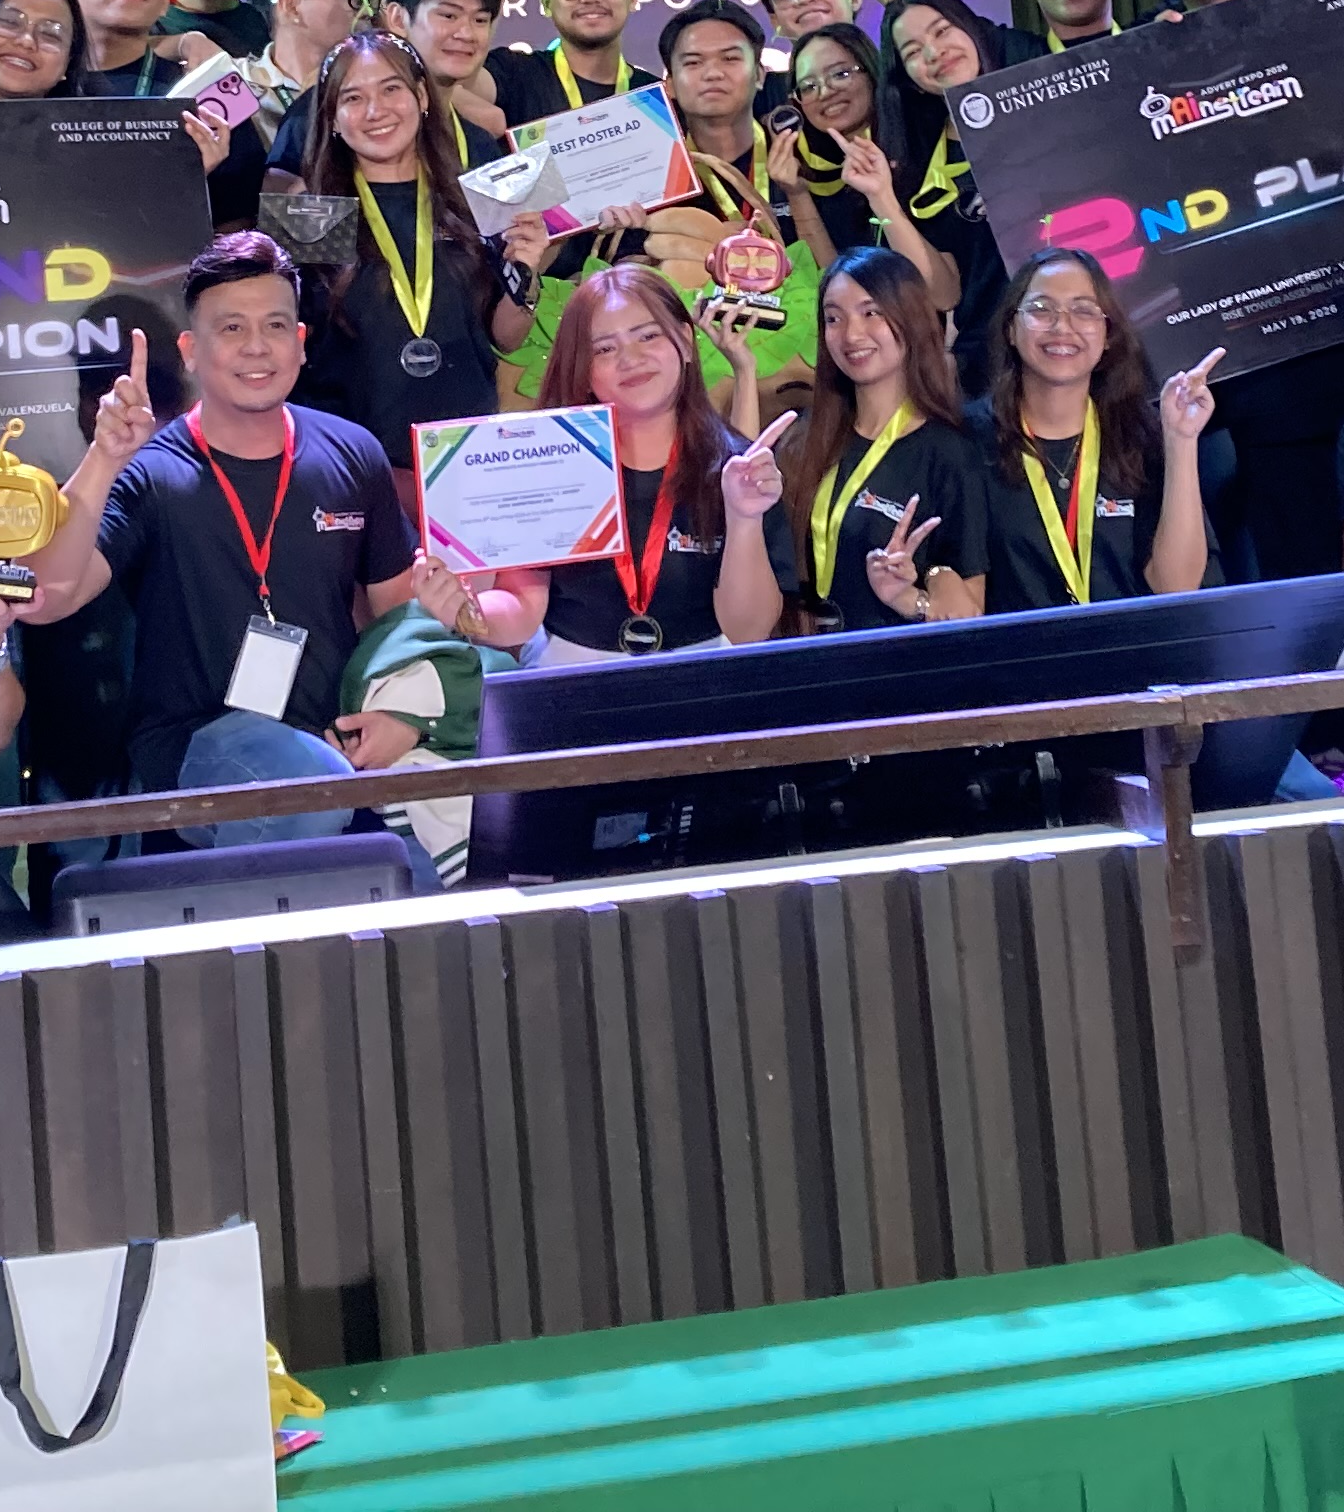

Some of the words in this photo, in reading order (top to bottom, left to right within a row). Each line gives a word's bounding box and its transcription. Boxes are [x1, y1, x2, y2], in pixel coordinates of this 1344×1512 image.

[996, 86, 1019, 100] OUR
[1020, 77, 1048, 92] LADY
[1052, 71, 1066, 82] OF
[1067, 59, 1109, 77] FATIMA
[999, 68, 1110, 113] UNIVERSITY
[1200, 79, 1237, 96] ADVERT
[1239, 71, 1264, 85] EXPO
[1266, 63, 1288, 76] 2026
[51, 122, 104, 131] COLLEGE
[107, 121, 121, 130] OF
[125, 120, 179, 130] BUSINESS
[58, 133, 83, 142] AND
[86, 131, 171, 142] ACCOUNTANCY
[550, 139, 577, 155] BEST
[578, 125, 622, 146] POSTER
[625, 119, 641, 132] AD
[1040, 189, 1229, 280] 2ND
[1166, 310, 1190, 325] OUR
[1190, 302, 1218, 318] LADY
[1219, 297, 1234, 309] OF
[1234, 285, 1274, 305] FATIMA
[1274, 266, 1331, 291] UNIVERSITY
[1220, 309, 1245, 322] RISE
[1245, 297, 1281, 314] TOWER
[1261, 321, 1287, 335] MAY
[1309, 304, 1338, 320] 2026
[464, 451, 510, 466] GRAND
[512, 442, 580, 461] CHAMPION
